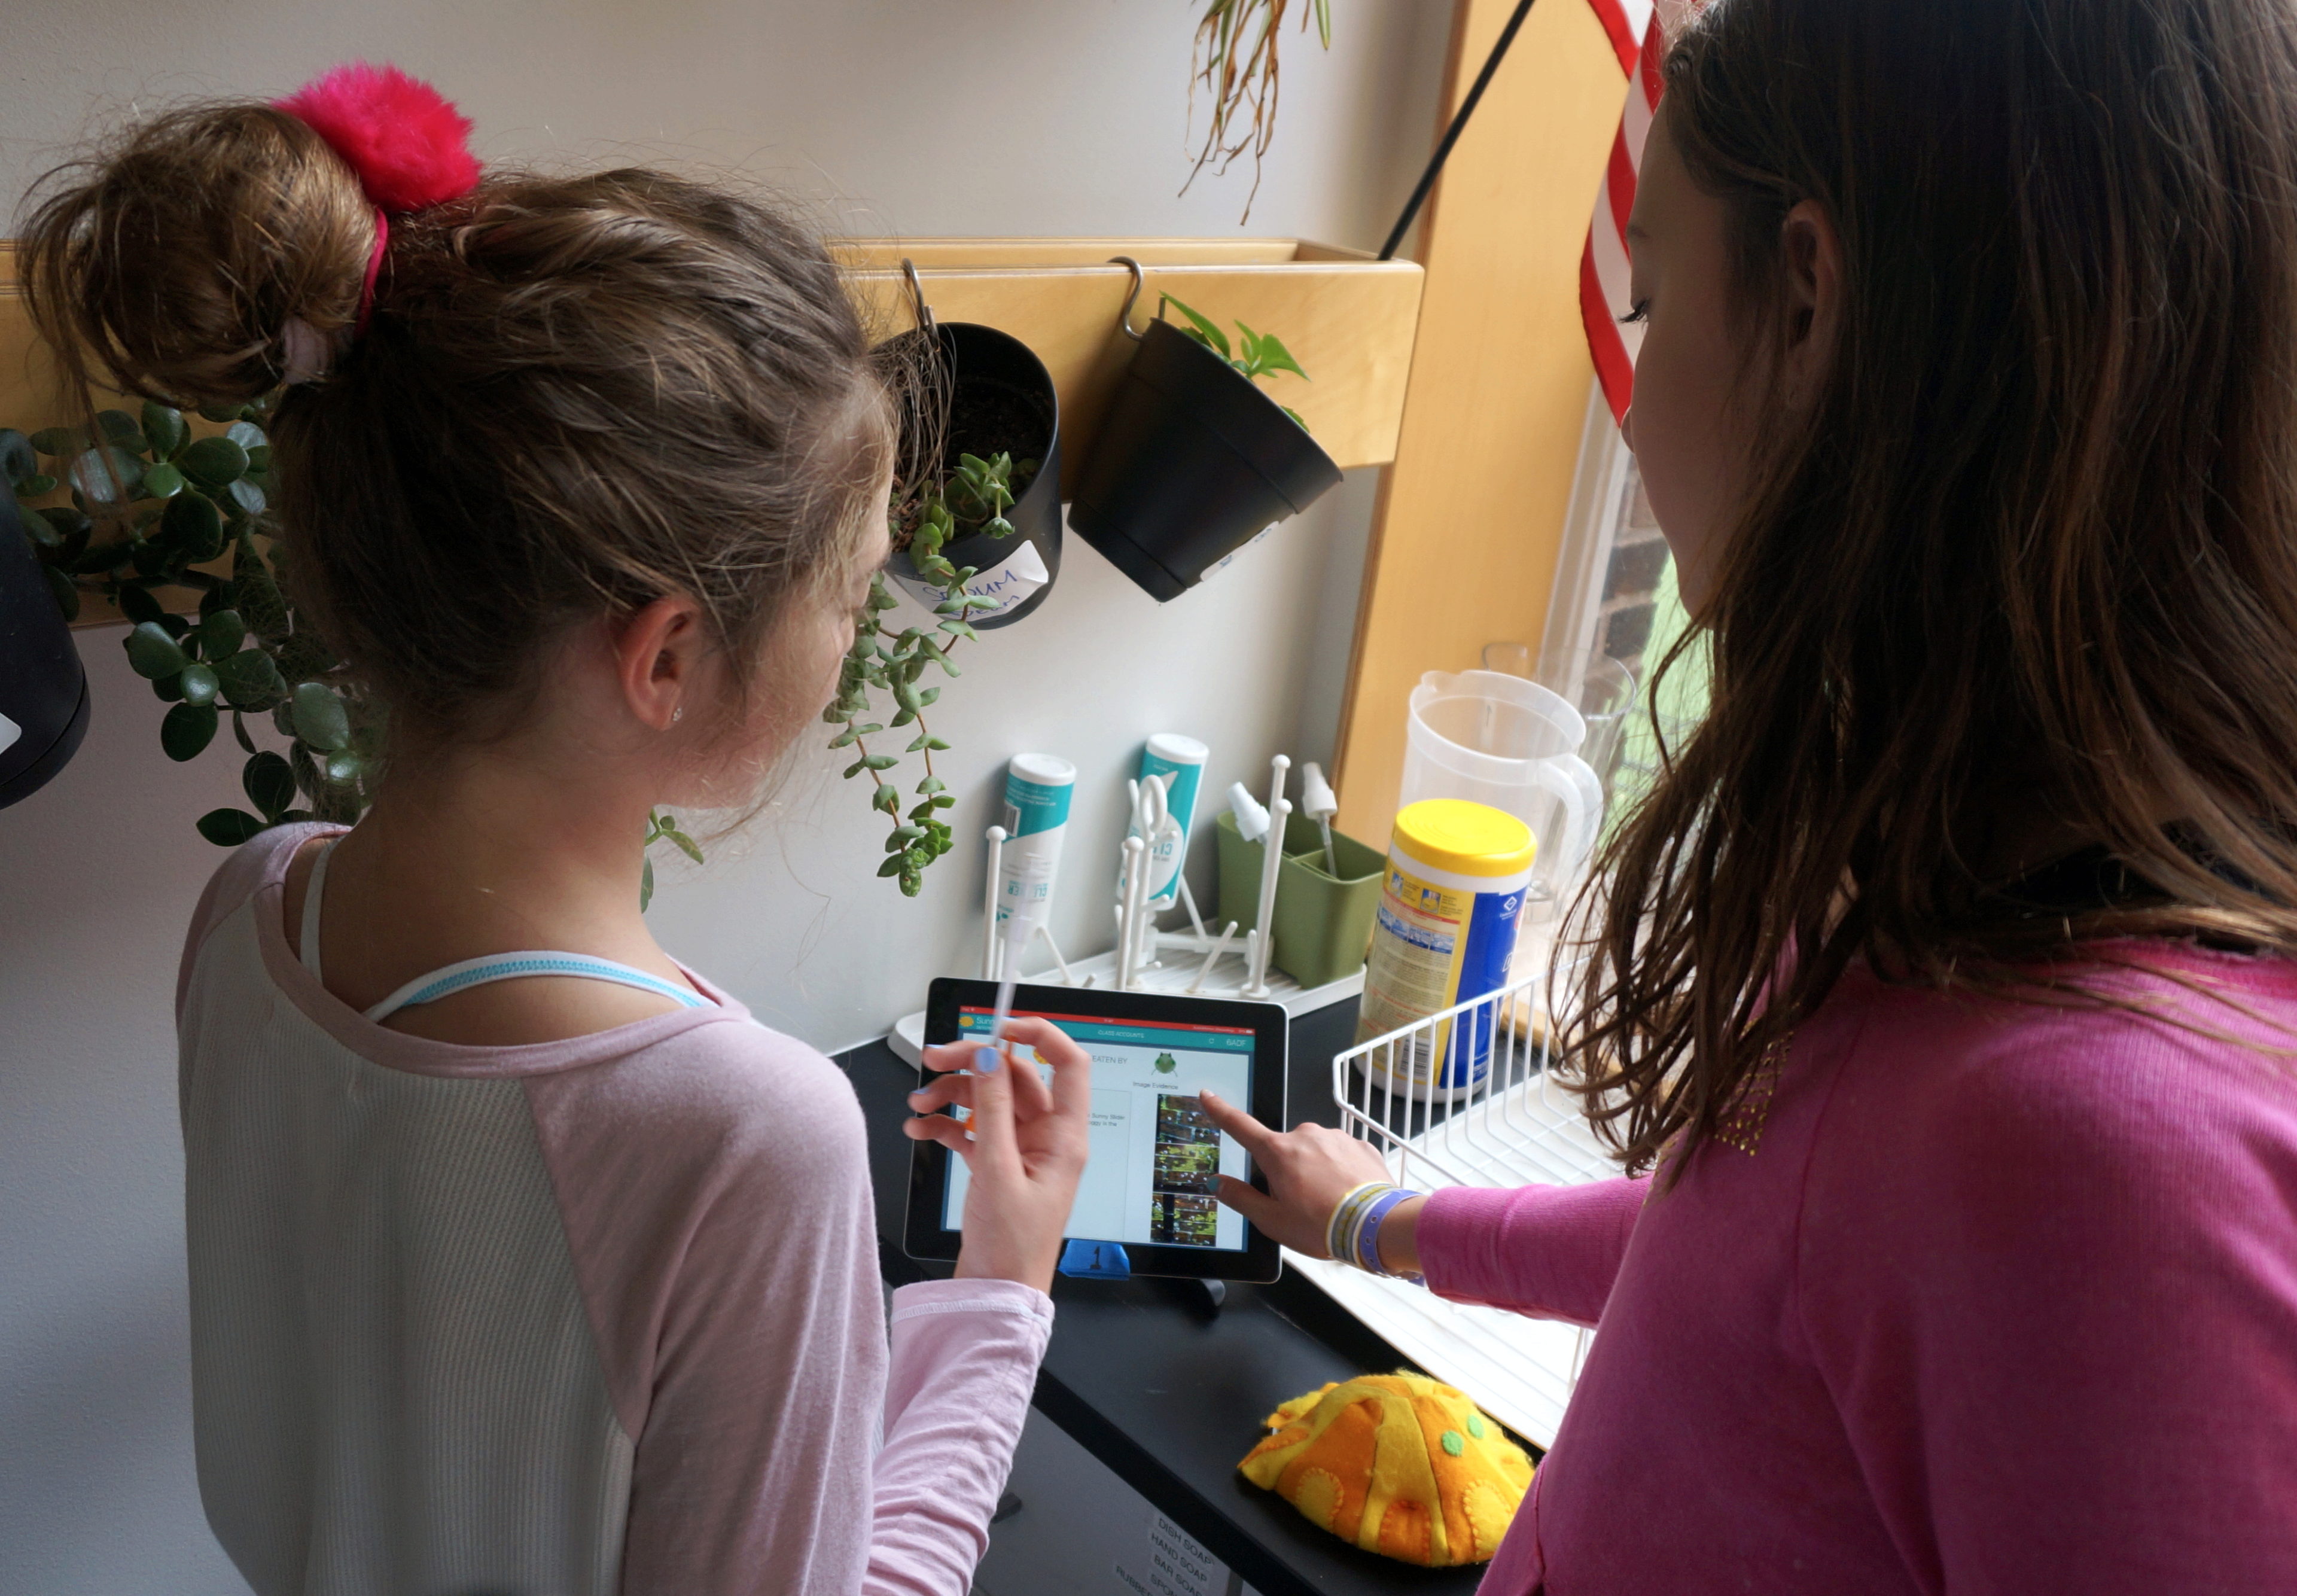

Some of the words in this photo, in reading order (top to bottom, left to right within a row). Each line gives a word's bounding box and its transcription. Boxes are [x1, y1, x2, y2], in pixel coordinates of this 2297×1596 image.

[976, 1016, 996, 1025] Sunn
[1092, 1055, 1116, 1064] EATEN
[1117, 1057, 1128, 1065] BY
[1132, 1081, 1151, 1089] Image
[1152, 1082, 1179, 1091] Evidence
[1090, 1245, 1102, 1269] 1
[1158, 1518, 1181, 1543] DISH
[1183, 1539, 1211, 1565] SOAP
[1151, 1533, 1178, 1560] HAND
[1180, 1557, 1207, 1583] SOAP
[1154, 1555, 1174, 1577] BAR
[1175, 1573, 1202, 1596] SOAP
